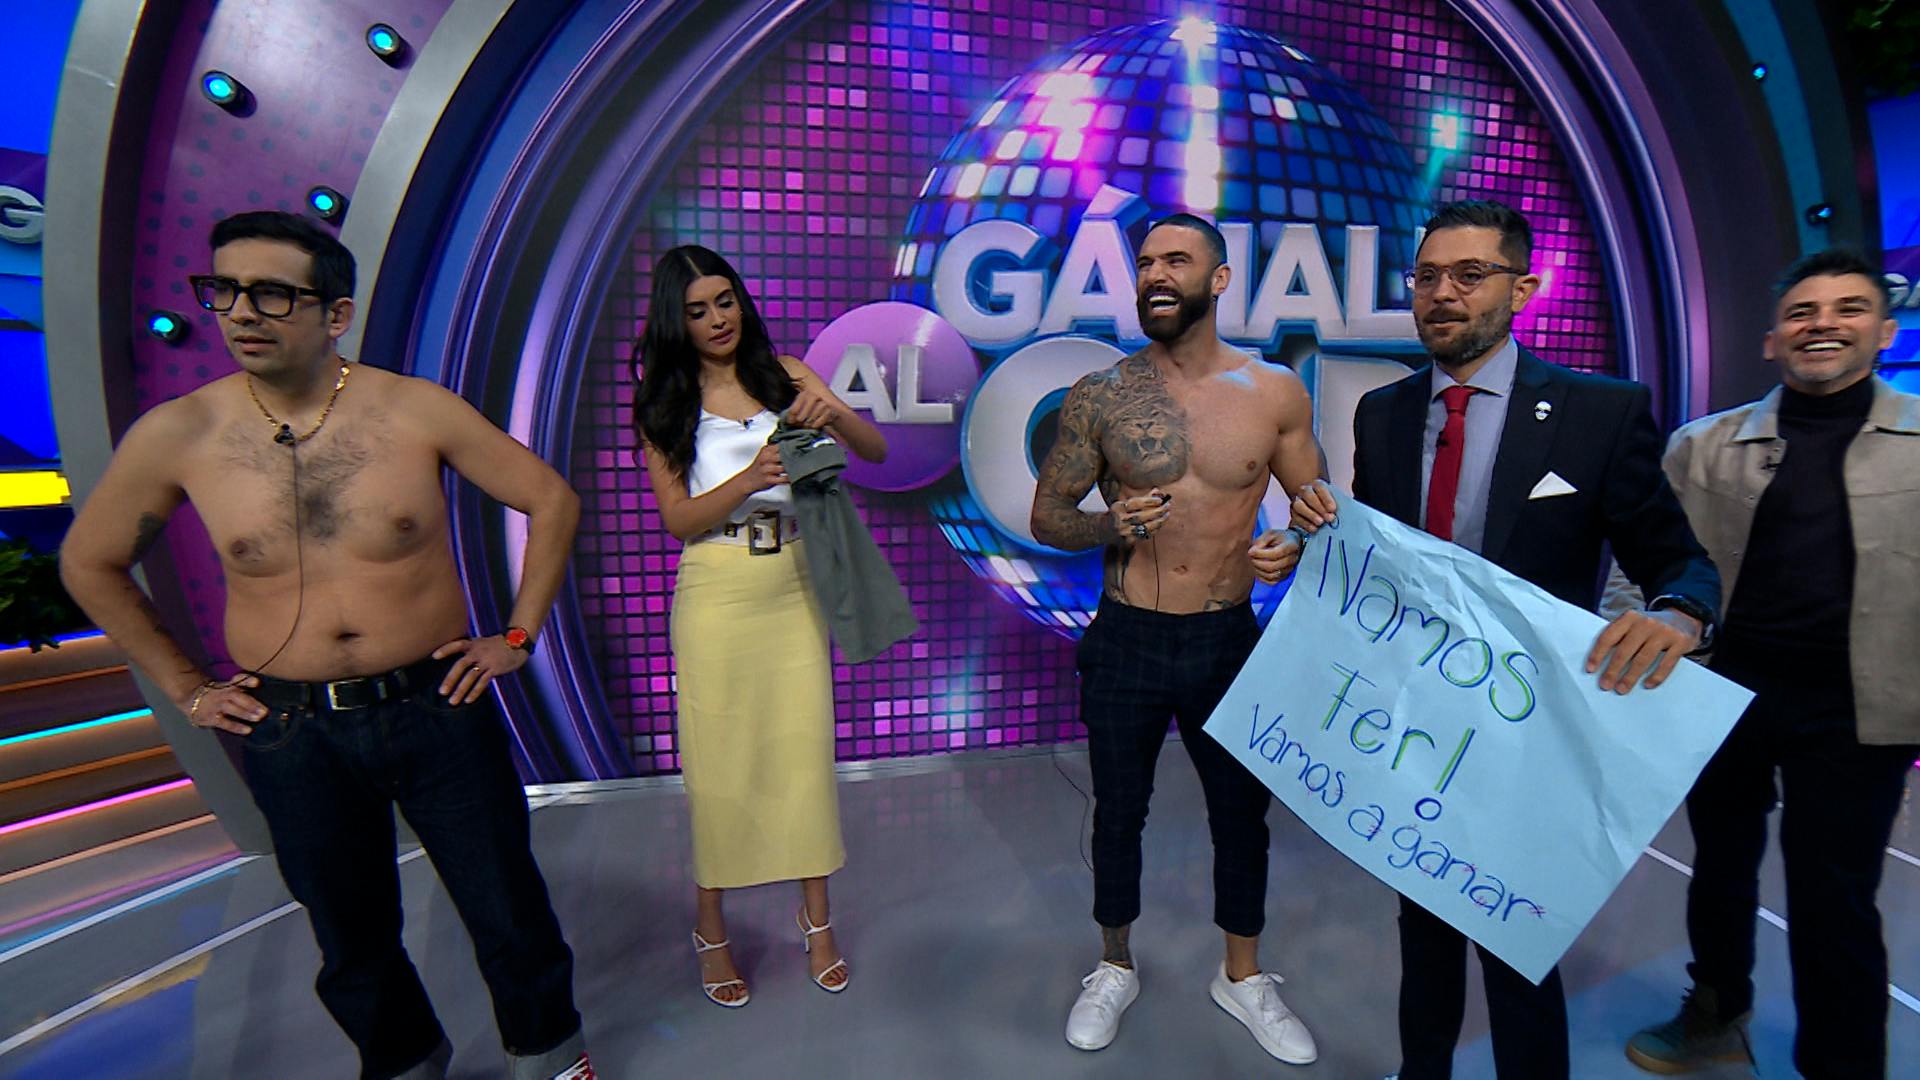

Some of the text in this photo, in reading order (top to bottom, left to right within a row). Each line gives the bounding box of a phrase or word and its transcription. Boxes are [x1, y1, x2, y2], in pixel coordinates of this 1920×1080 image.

[829, 343, 953, 424] AL
[1249, 703, 1545, 922] Vamos a ganar
[1321, 662, 1476, 821] Fer!
